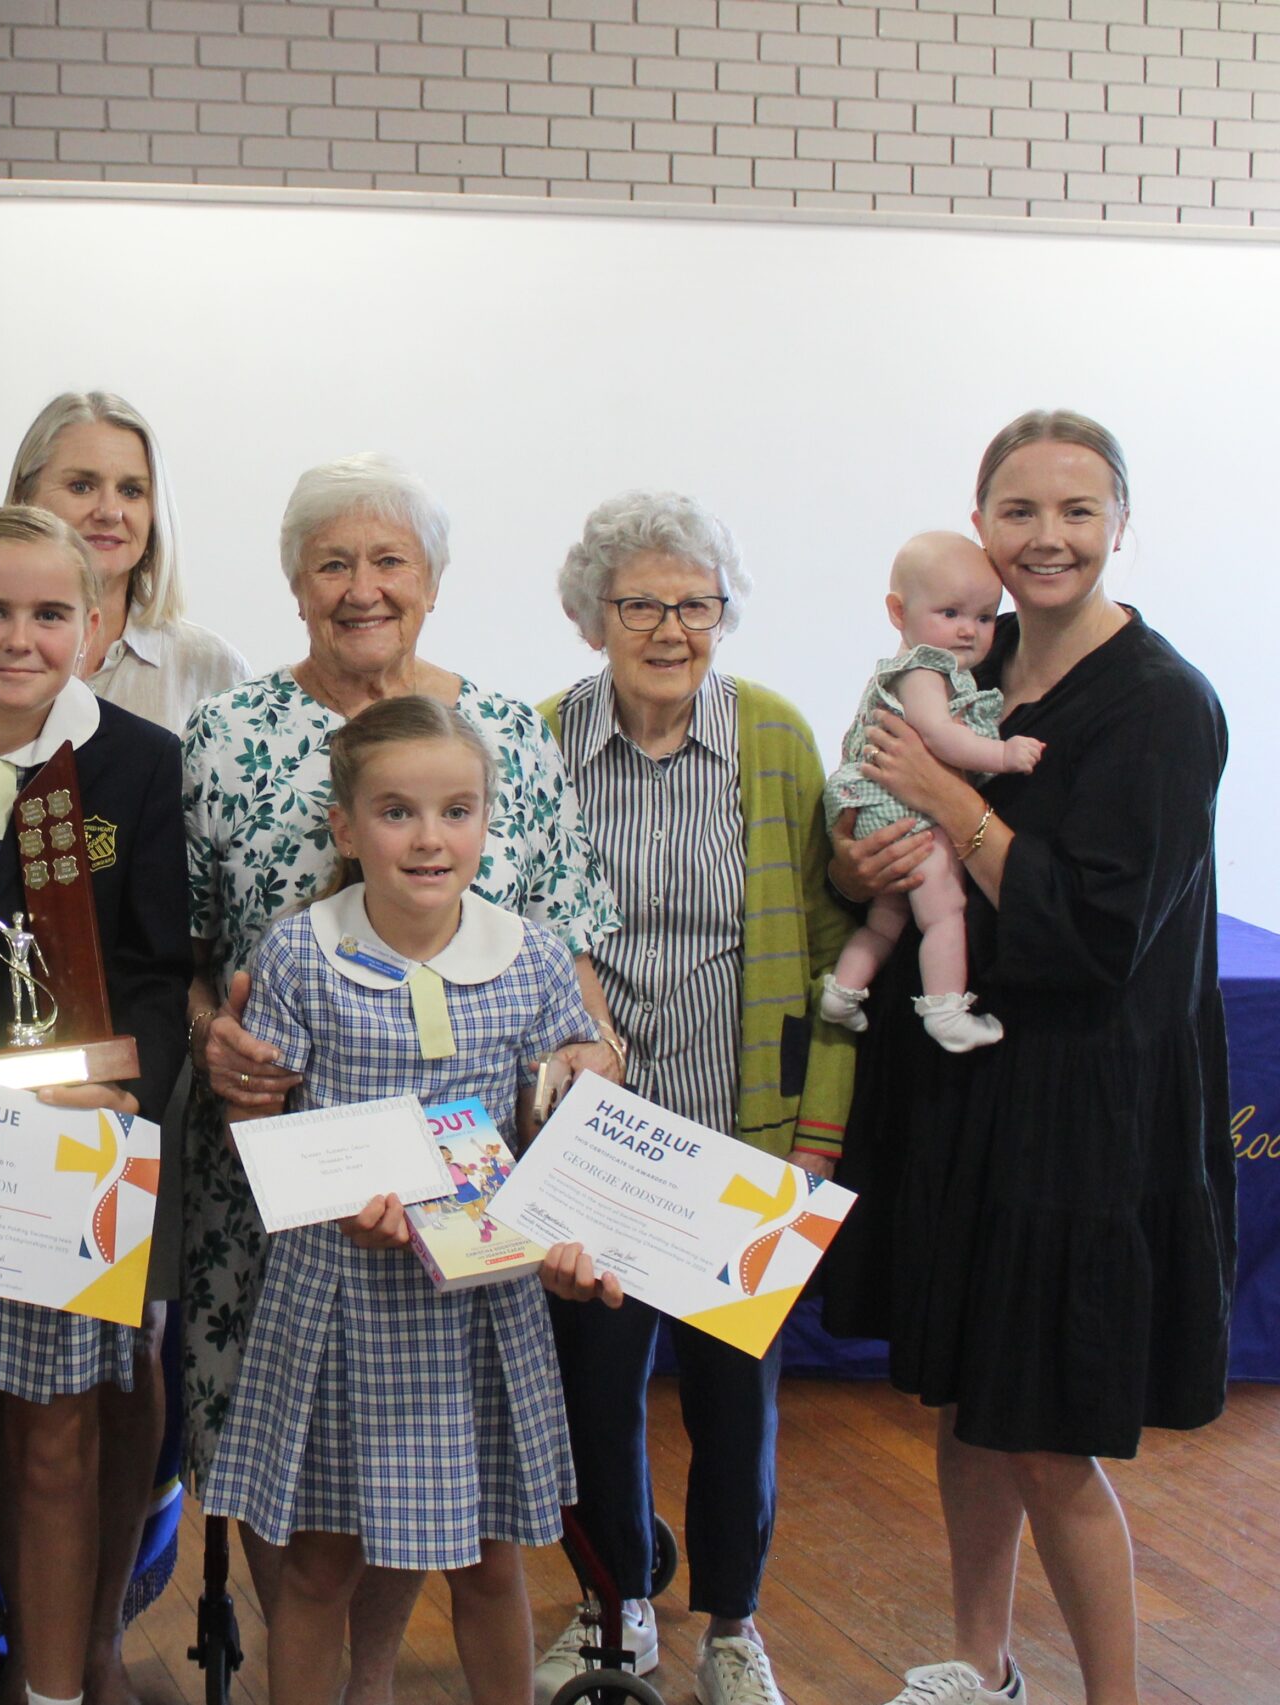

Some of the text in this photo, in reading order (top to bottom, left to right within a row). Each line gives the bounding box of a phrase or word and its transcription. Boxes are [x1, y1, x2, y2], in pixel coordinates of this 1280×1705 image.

[584, 1117, 665, 1162] AWARD
[595, 1099, 702, 1158] HALF BLUE
[562, 1150, 696, 1220] GEORGIE RODSTROM
[574, 1134, 588, 1146] THIS
[588, 1142, 628, 1168] CERTIFICATE
[627, 1162, 635, 1170] IS
[635, 1167, 668, 1187] AWARDED
